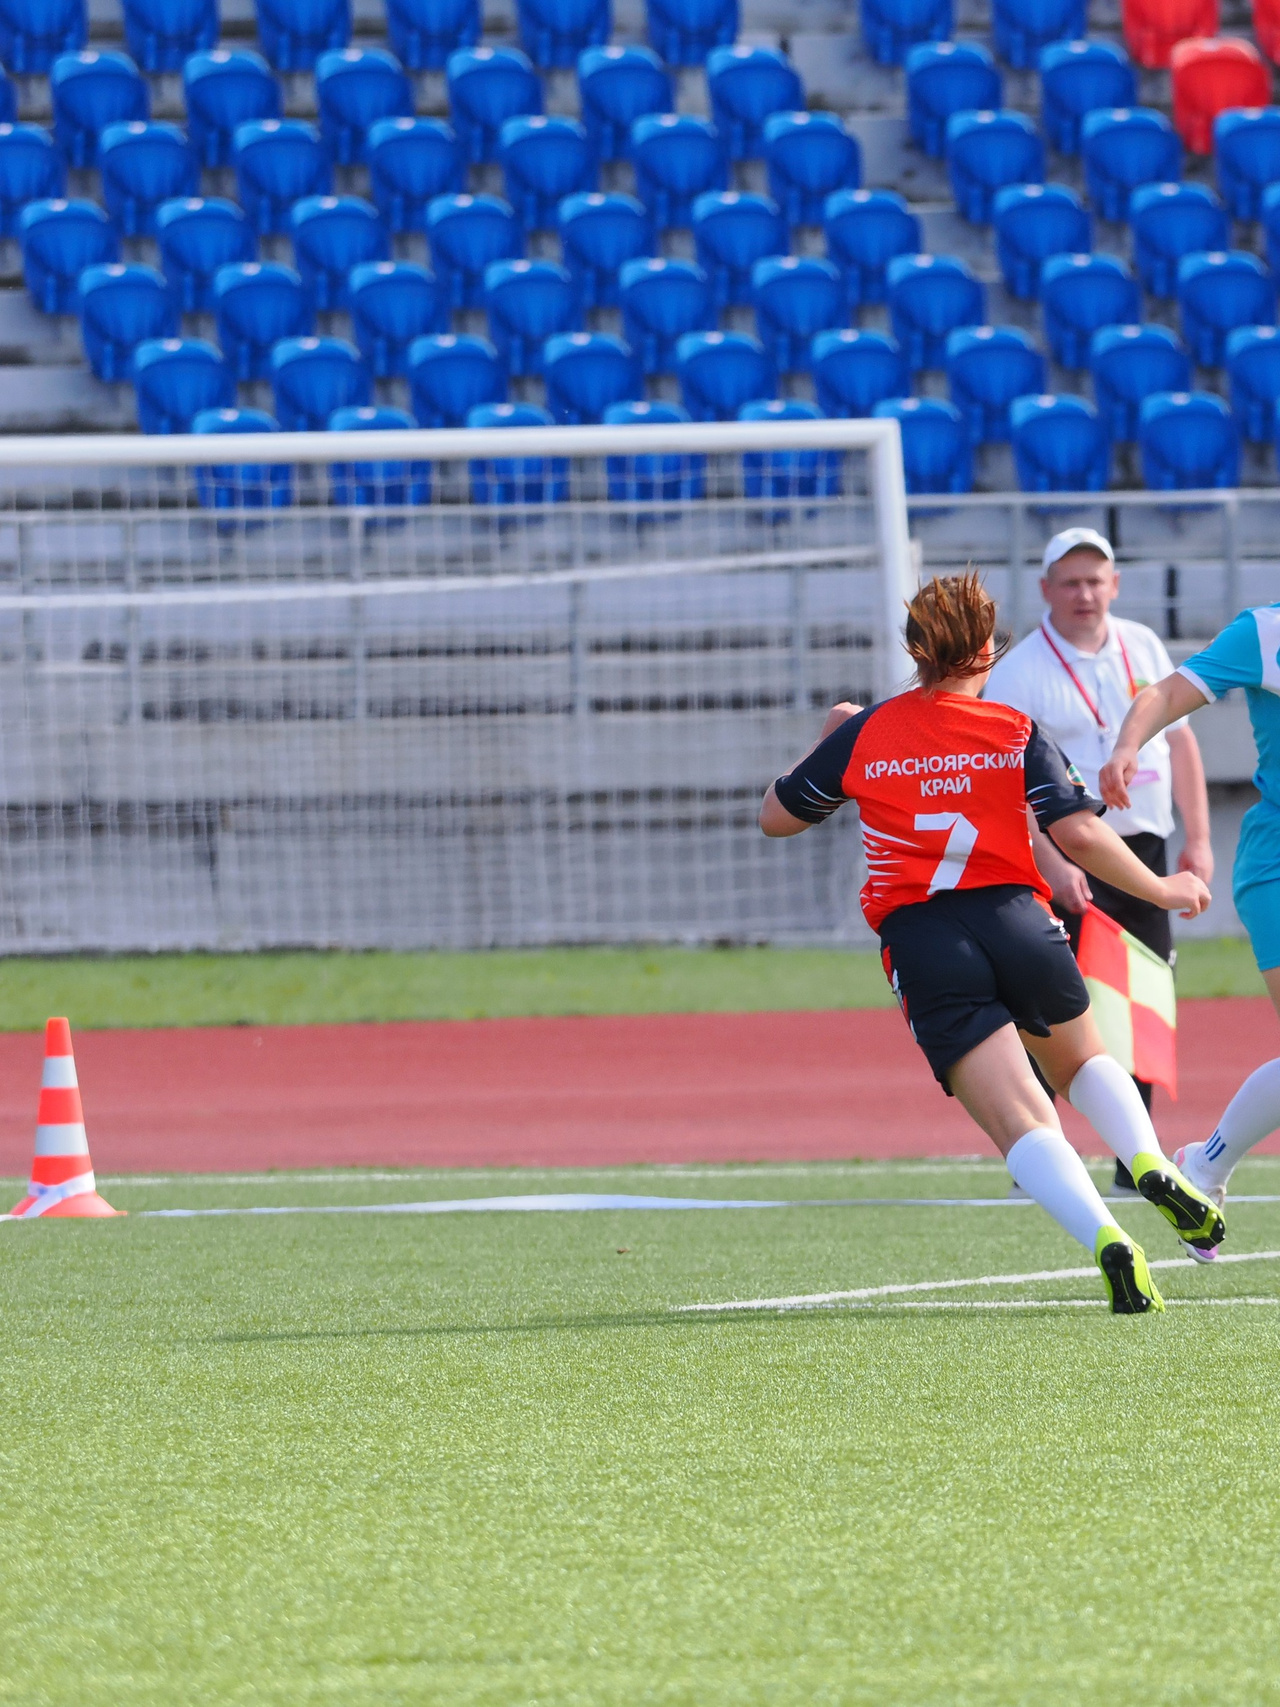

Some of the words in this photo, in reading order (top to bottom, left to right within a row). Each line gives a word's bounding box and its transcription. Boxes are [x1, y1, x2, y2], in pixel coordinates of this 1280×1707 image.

[865, 750, 1025, 780] КРАСНОЯРСКИЙ
[920, 773, 971, 797] КРАЙ
[914, 813, 979, 895] 7
